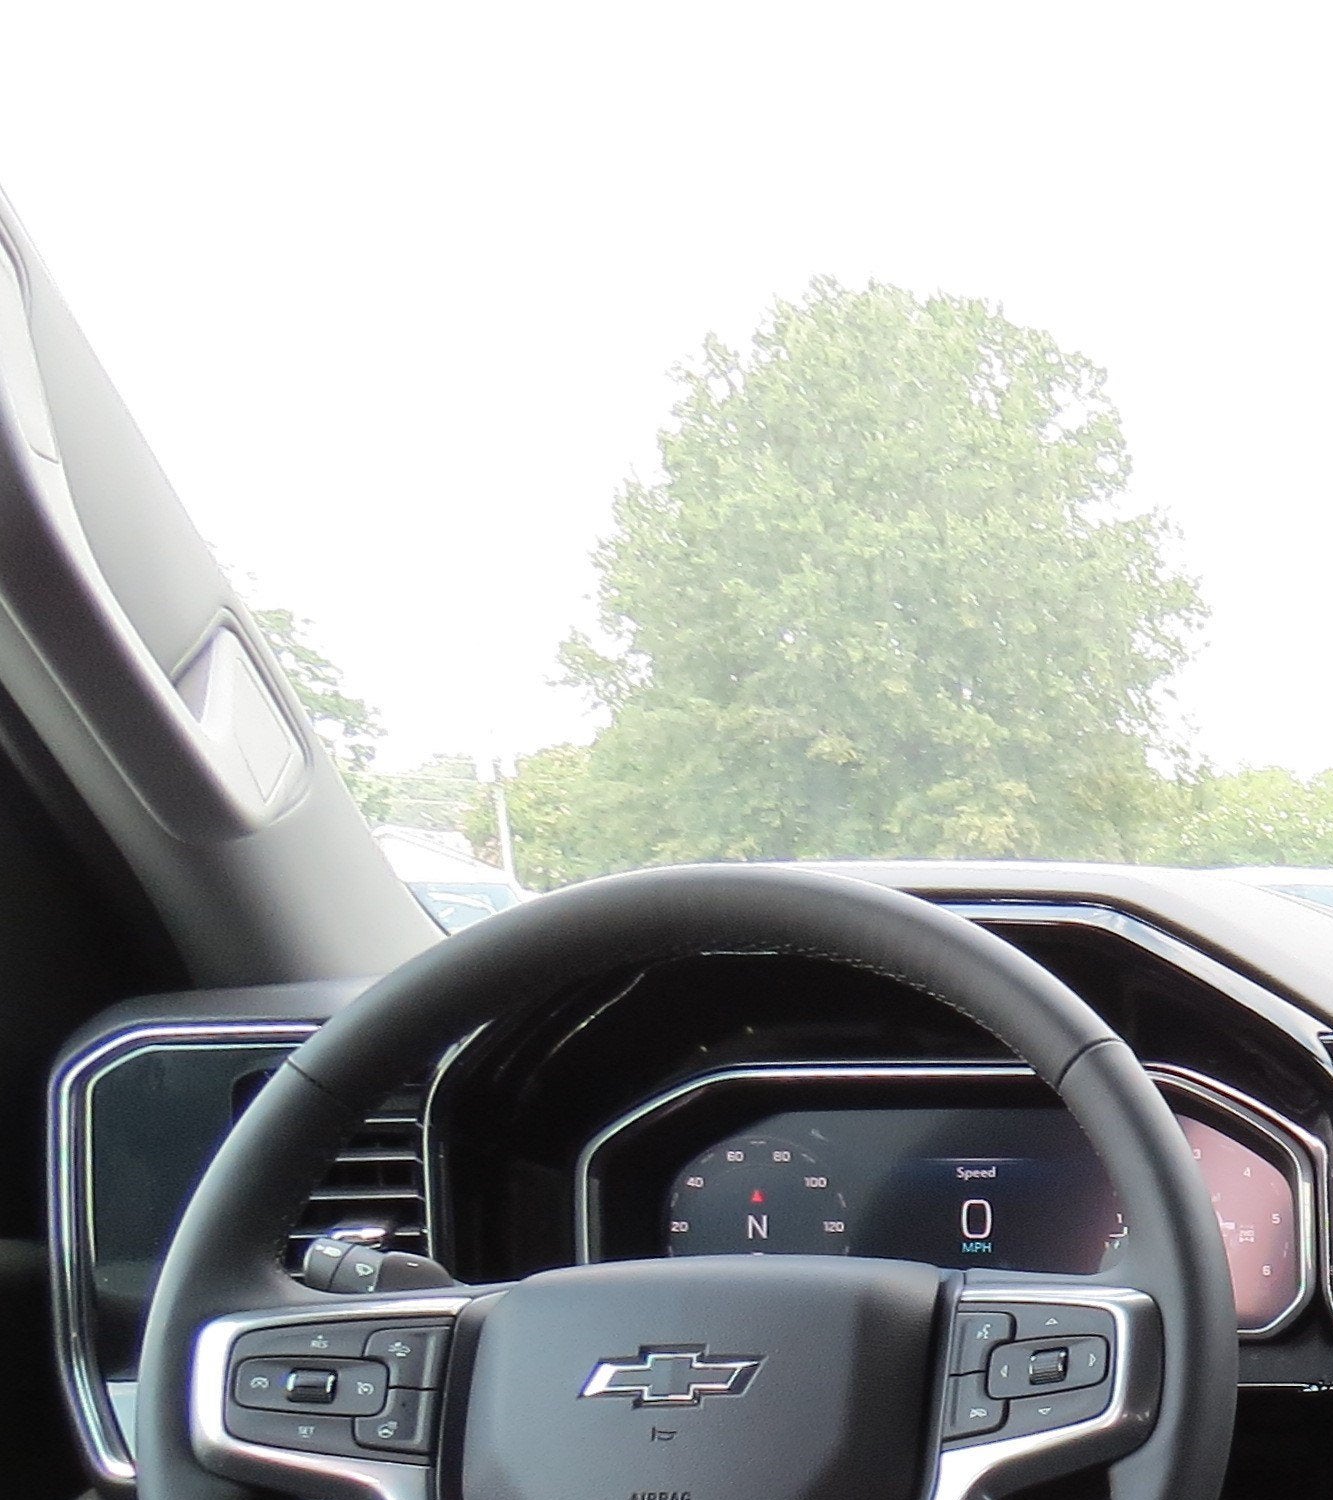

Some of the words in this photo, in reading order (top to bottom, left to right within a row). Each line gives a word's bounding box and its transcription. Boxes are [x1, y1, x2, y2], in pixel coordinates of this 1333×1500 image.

[726, 1151, 744, 1162] 60
[773, 1151, 791, 1162] 80
[956, 1167, 996, 1180] Speed
[1243, 1167, 1251, 1178] 4
[686, 1176, 703, 1188] 40
[804, 1177, 827, 1188] 100
[961, 1199, 992, 1239] 0
[1272, 1213, 1281, 1224] 5
[671, 1221, 688, 1232] 20
[747, 1214, 768, 1239] N
[824, 1221, 845, 1232] 120
[961, 1242, 992, 1253] MPH
